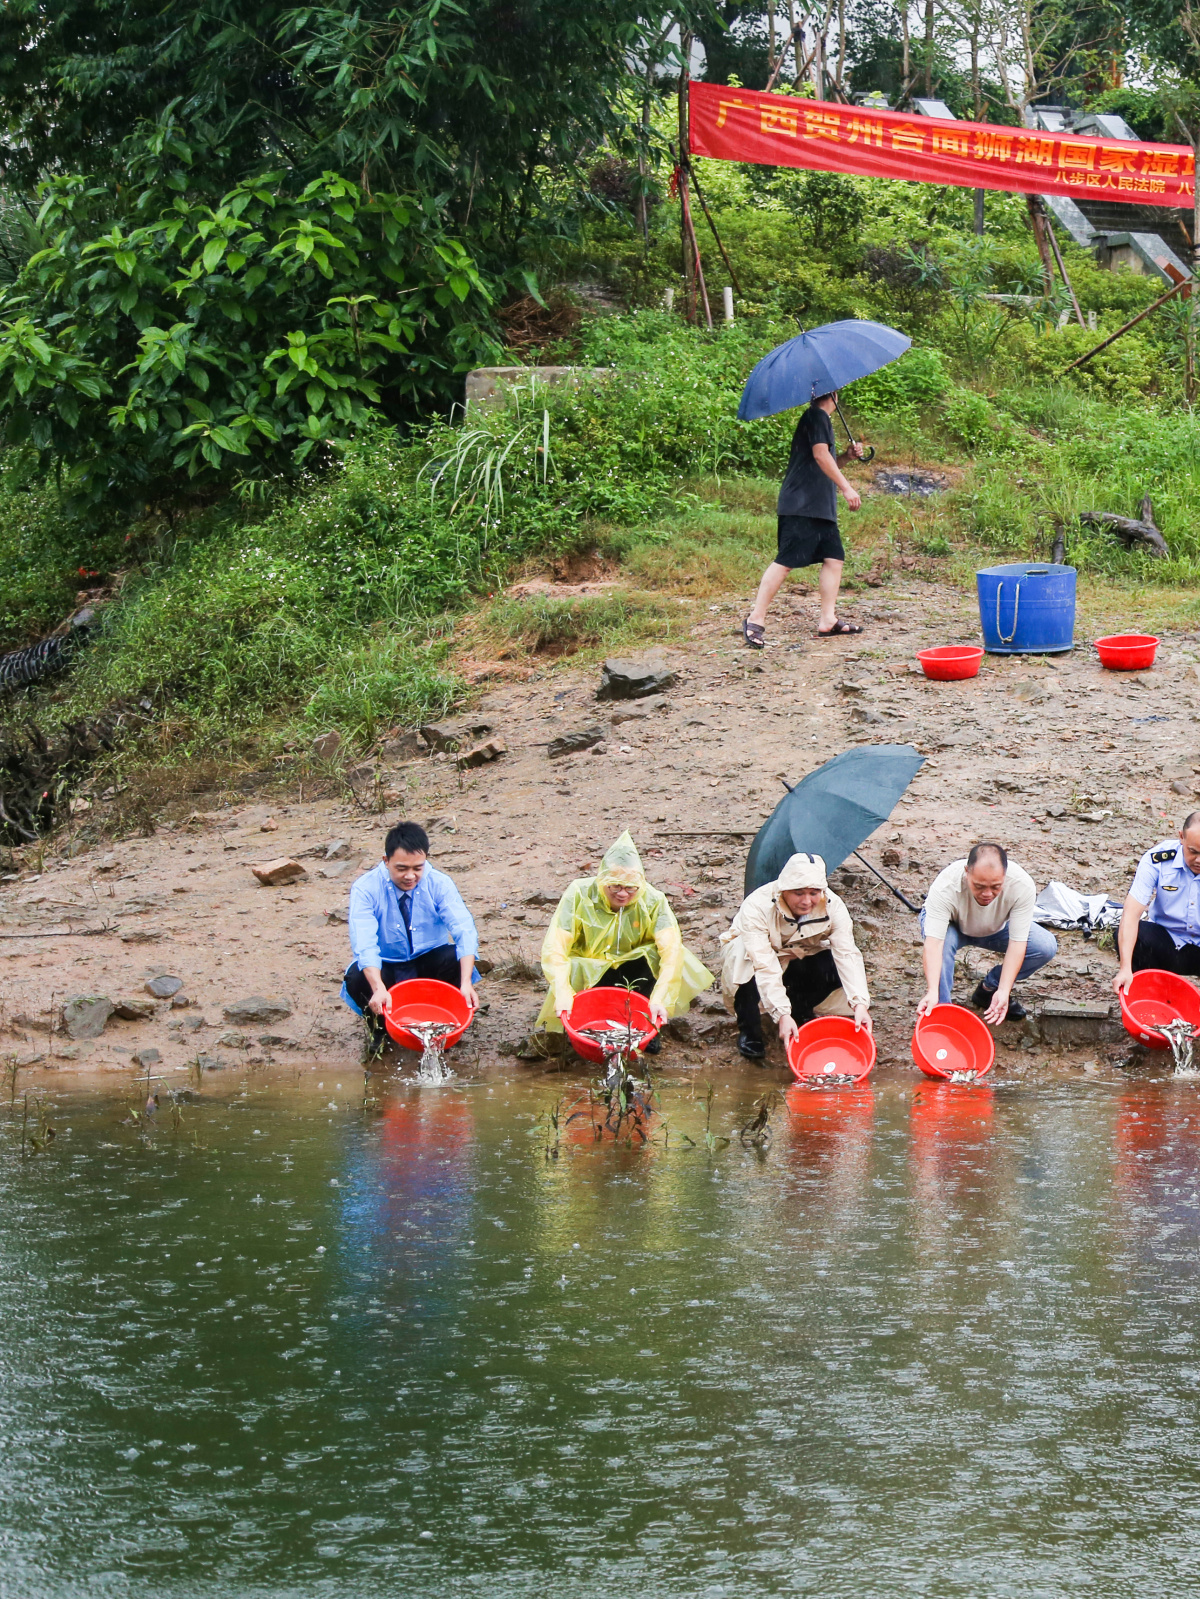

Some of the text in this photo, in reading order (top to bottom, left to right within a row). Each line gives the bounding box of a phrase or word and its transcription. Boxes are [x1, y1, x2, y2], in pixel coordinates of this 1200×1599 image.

[1053, 170, 1166, 194] 八步区人民法院
